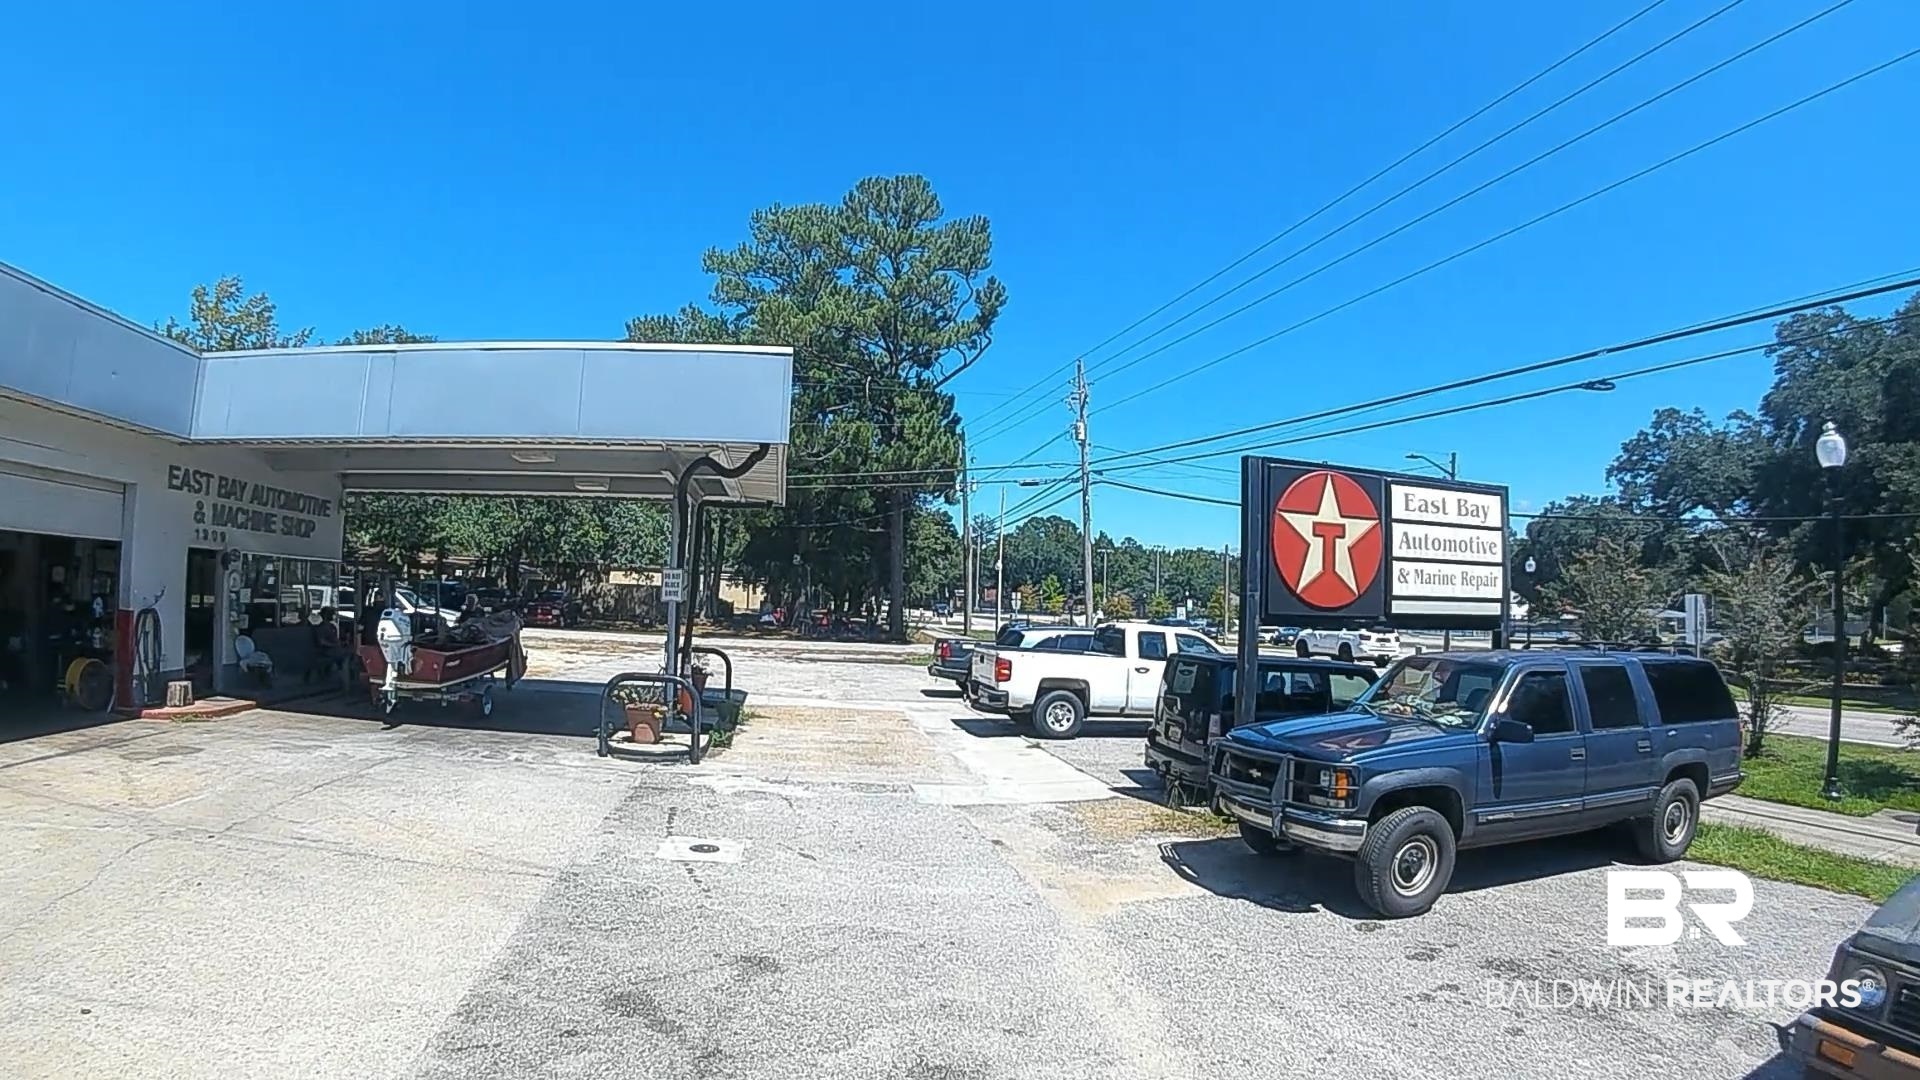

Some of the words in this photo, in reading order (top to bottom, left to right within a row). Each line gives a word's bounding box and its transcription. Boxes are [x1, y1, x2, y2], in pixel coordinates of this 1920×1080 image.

[168, 464, 215, 496] EAST
[217, 475, 248, 502] BAY
[250, 483, 332, 518] AUTOMOTIVE
[193, 500, 206, 525] &
[212, 502, 277, 534] MACHINE
[280, 515, 316, 539] SHOP
[1404, 492, 1449, 515] East
[1456, 498, 1490, 524] Bay
[1399, 531, 1498, 555] Automotive
[1397, 567, 1409, 584] &
[1414, 568, 1457, 587] Marine
[1461, 571, 1499, 590] Repair
